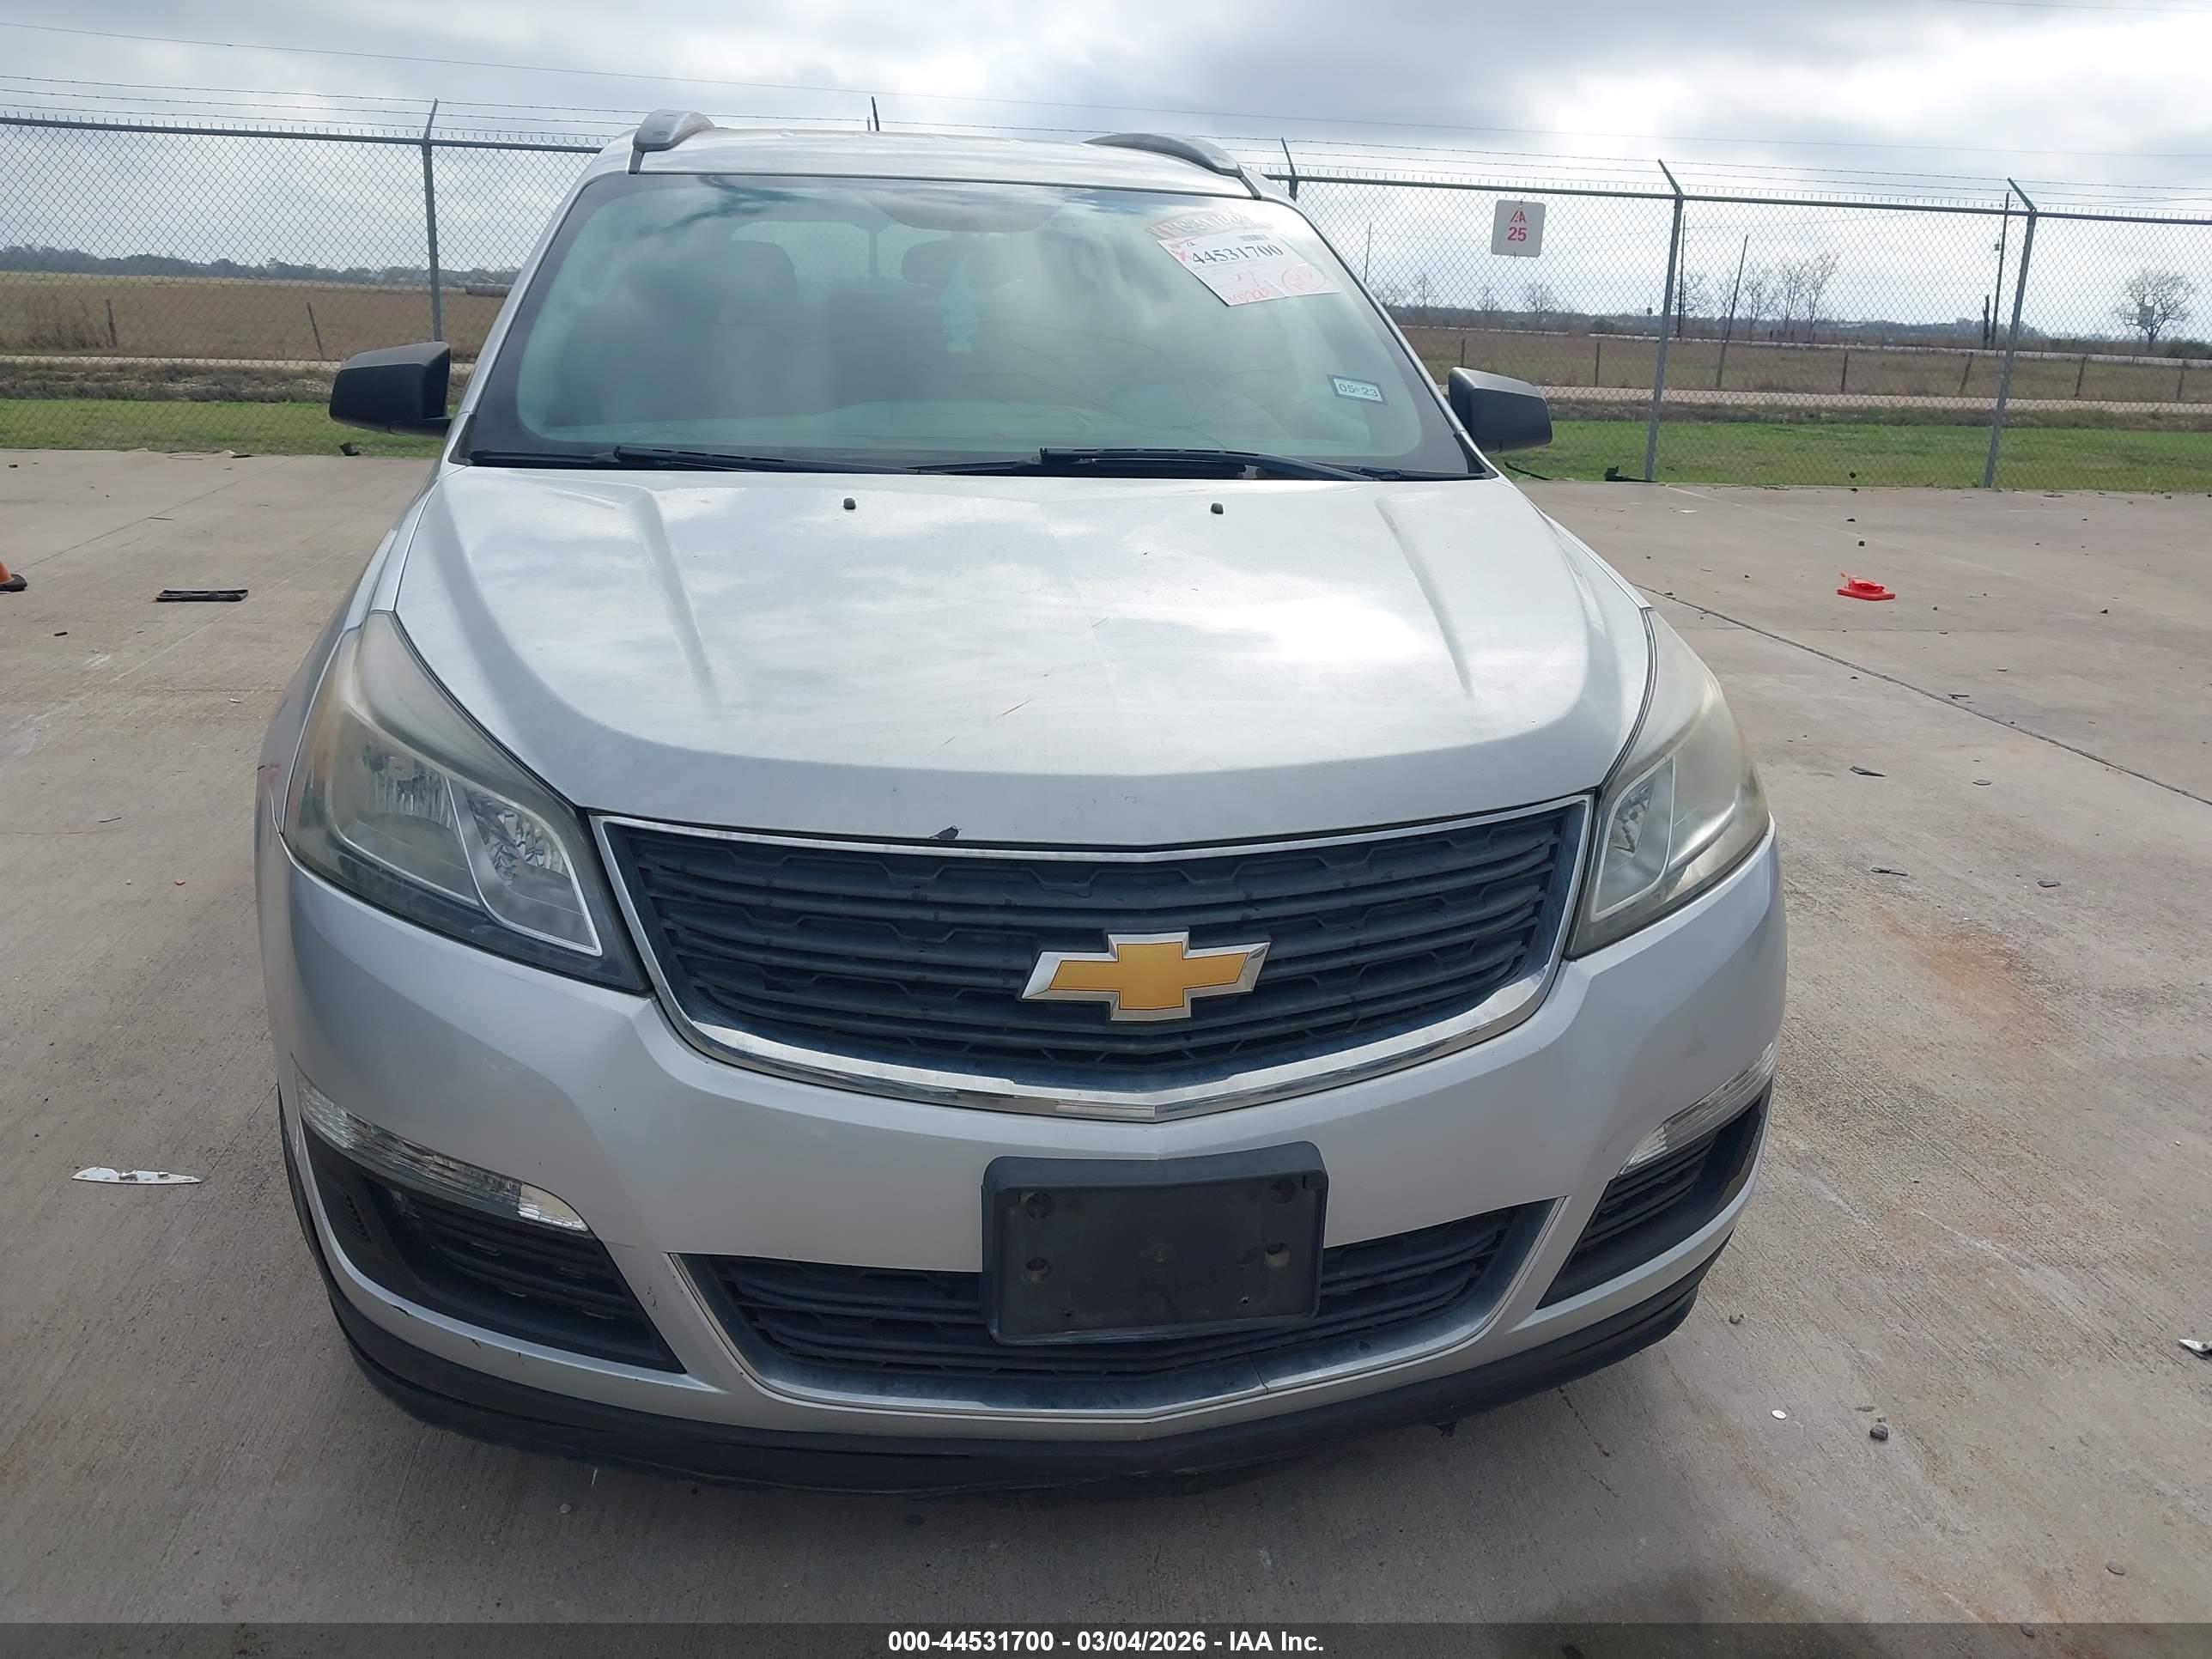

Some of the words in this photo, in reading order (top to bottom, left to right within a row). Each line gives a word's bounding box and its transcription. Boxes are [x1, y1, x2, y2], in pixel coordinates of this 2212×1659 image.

[1507, 227, 1528, 241] 25
[1191, 244, 1285, 264] 44531700
[1339, 383, 1355, 393] 05
[1361, 386, 1378, 398] 23
